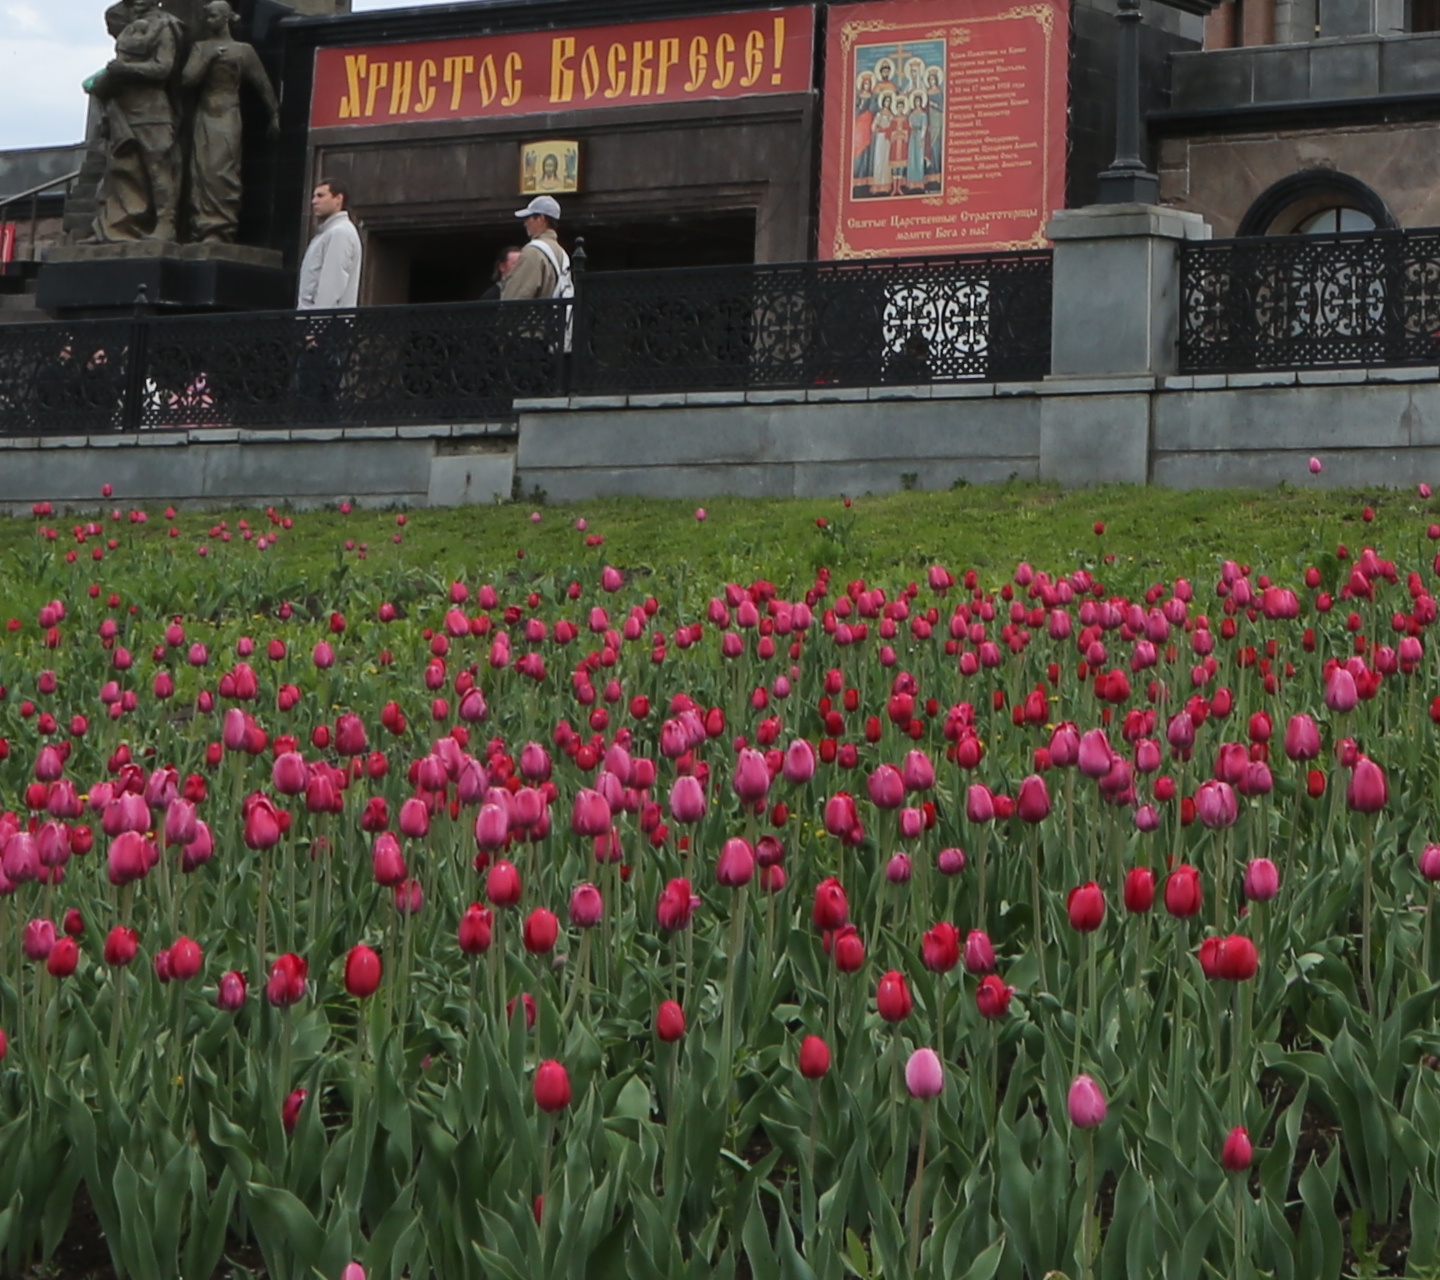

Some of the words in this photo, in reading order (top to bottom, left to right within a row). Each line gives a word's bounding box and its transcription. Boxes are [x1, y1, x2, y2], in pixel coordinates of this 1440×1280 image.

[847, 217, 886, 229] Святые
[890, 214, 957, 227] Царственные
[960, 207, 1038, 223] Страстотерпцы
[895, 230, 932, 241] молите
[935, 226, 958, 238] Бога
[961, 229, 967, 237] о
[969, 224, 990, 236] нас!
